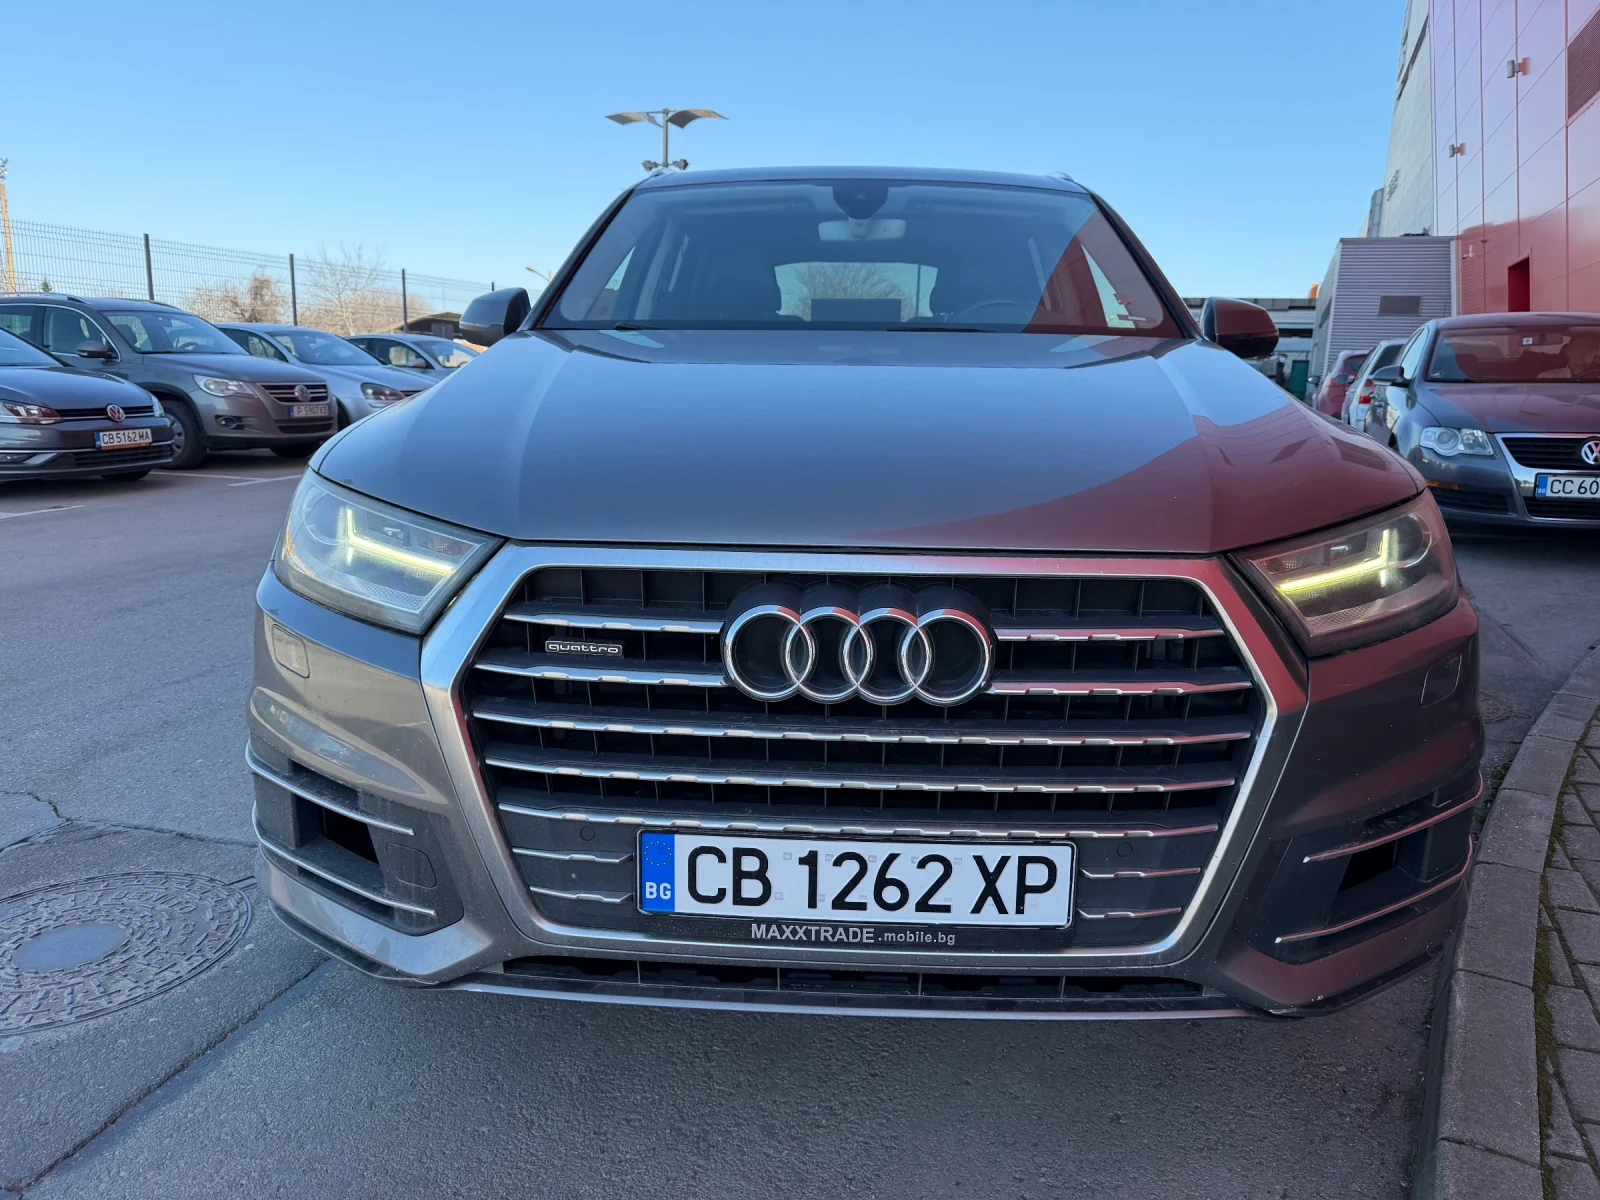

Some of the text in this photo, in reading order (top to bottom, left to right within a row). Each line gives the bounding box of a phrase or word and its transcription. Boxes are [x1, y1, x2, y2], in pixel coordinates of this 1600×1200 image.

[1550, 479, 1574, 494] CC
[549, 644, 618, 653] quattro
[688, 845, 1058, 914] CB 1262 XP
[645, 882, 671, 900] BG
[751, 923, 875, 943] MAXXTRADE
